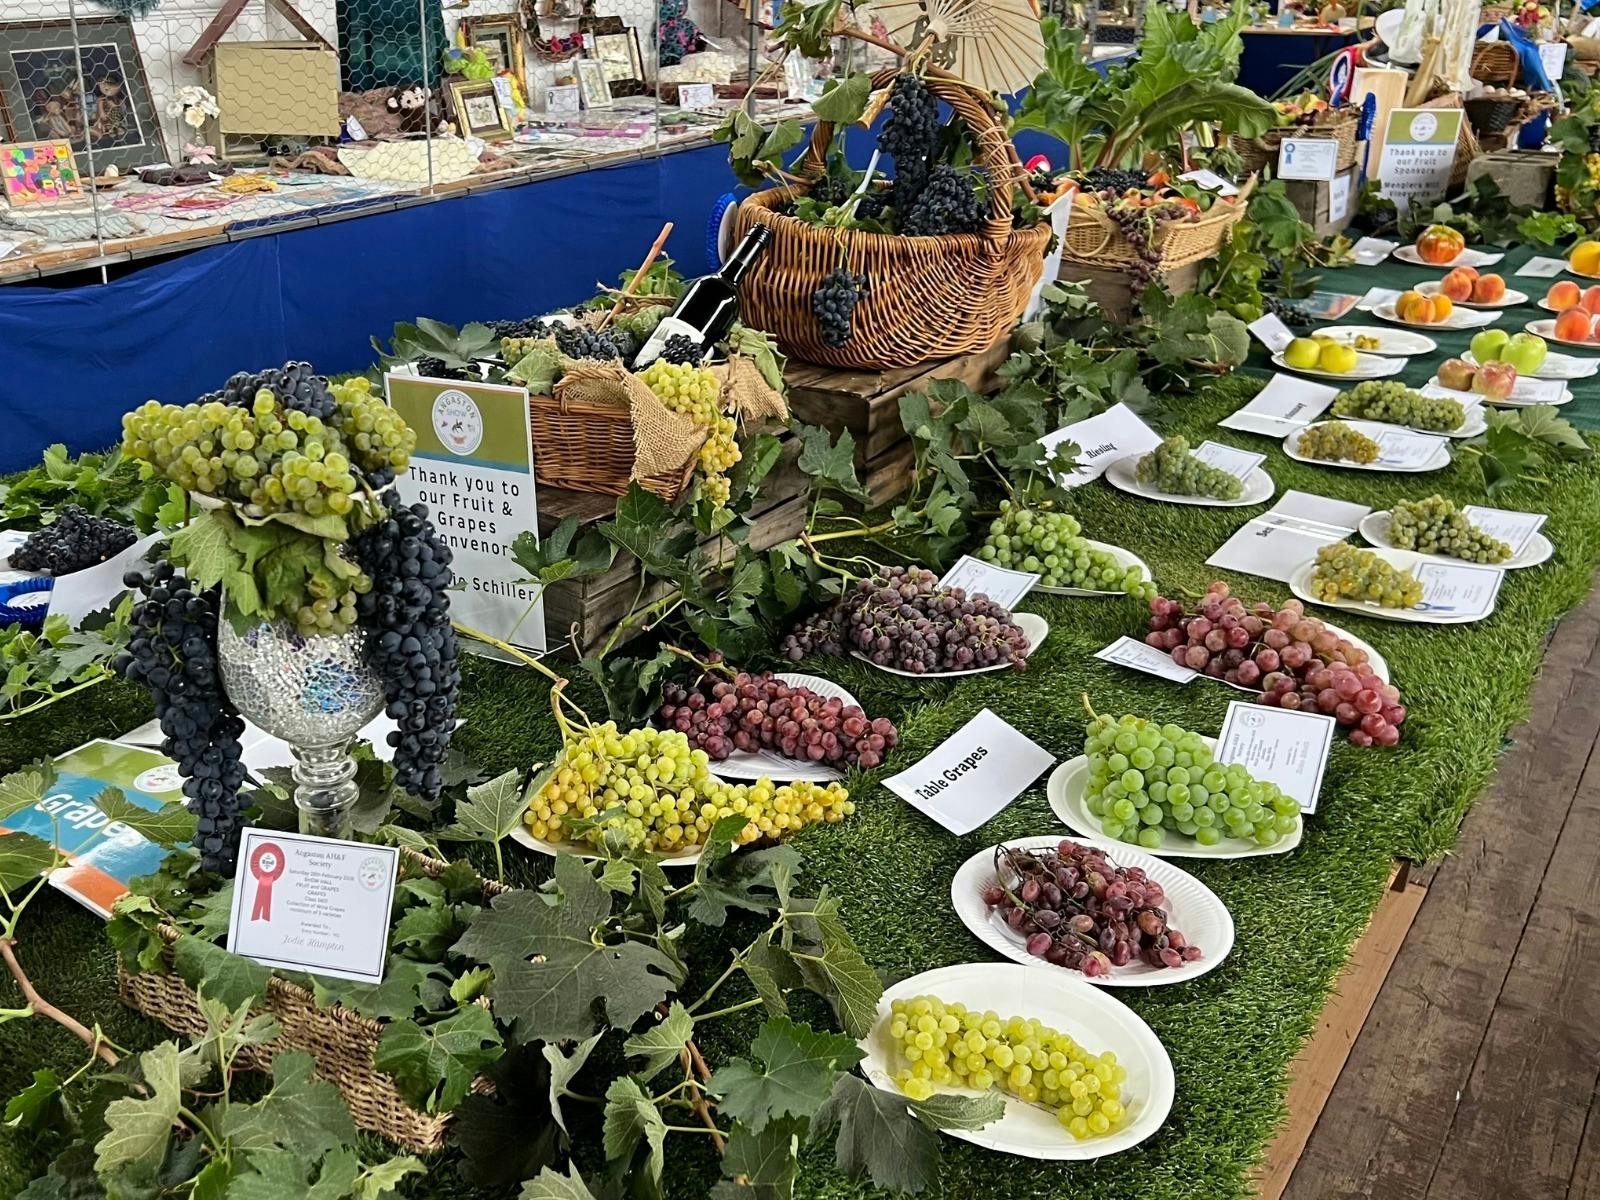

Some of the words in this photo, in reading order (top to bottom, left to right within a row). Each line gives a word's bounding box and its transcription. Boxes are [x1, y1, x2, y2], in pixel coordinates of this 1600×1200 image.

[1390, 148, 1415, 156] Thank
[1419, 149, 1435, 157] you
[1438, 148, 1448, 156] to
[438, 396, 476, 419] ANGASTON
[1085, 442, 1117, 459] Riesling
[409, 466, 458, 487] Thank
[465, 477, 494, 492] you
[502, 480, 519, 496] to
[419, 490, 445, 505] our
[453, 493, 494, 513] Fruit
[502, 501, 513, 516] &
[438, 511, 496, 534] Grapes
[437, 533, 508, 556] onvenor
[472, 577, 535, 601] Schiller
[915, 780, 949, 800] Table
[943, 746, 988, 781] Grapes
